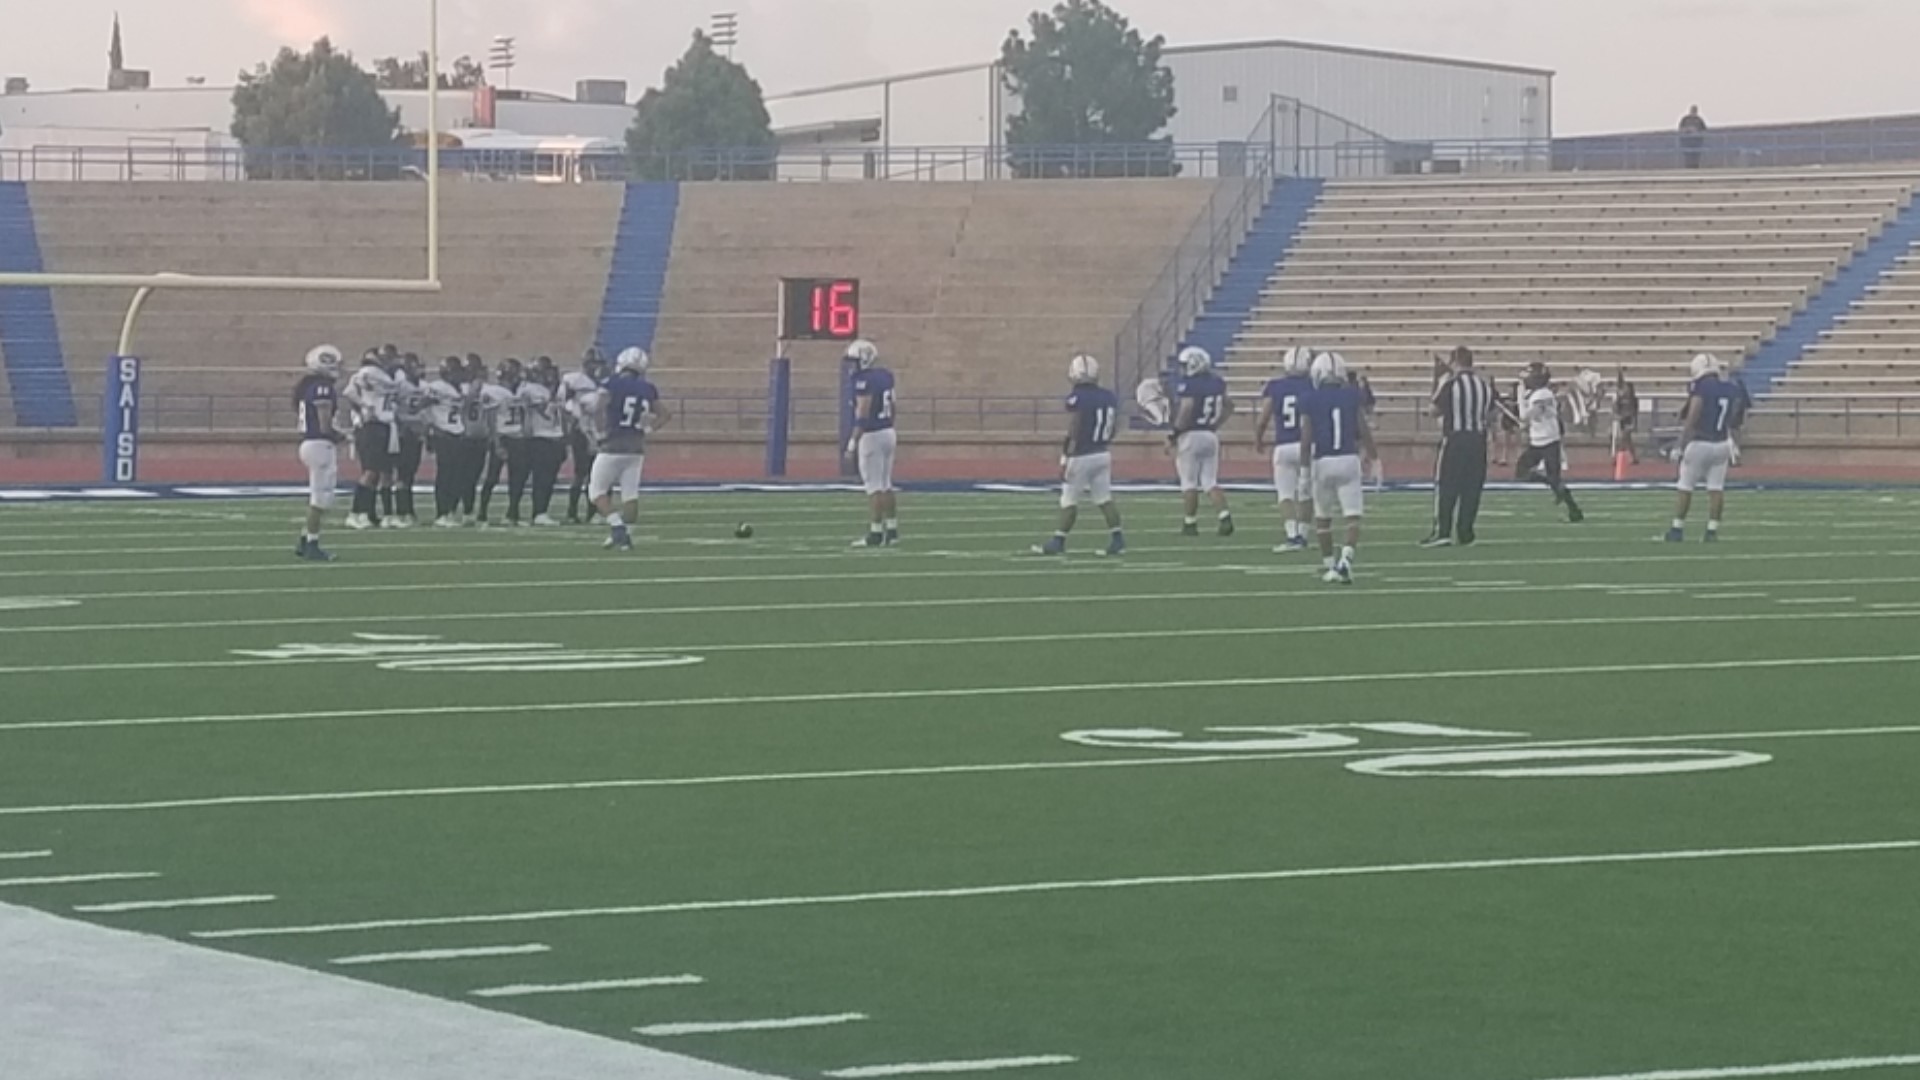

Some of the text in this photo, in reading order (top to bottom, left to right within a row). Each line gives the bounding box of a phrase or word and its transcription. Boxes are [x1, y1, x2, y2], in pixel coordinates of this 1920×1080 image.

[811, 281, 856, 336] 16
[117, 357, 137, 481] SAISD
[1332, 407, 1341, 450] 1
[1716, 398, 1729, 431] 7
